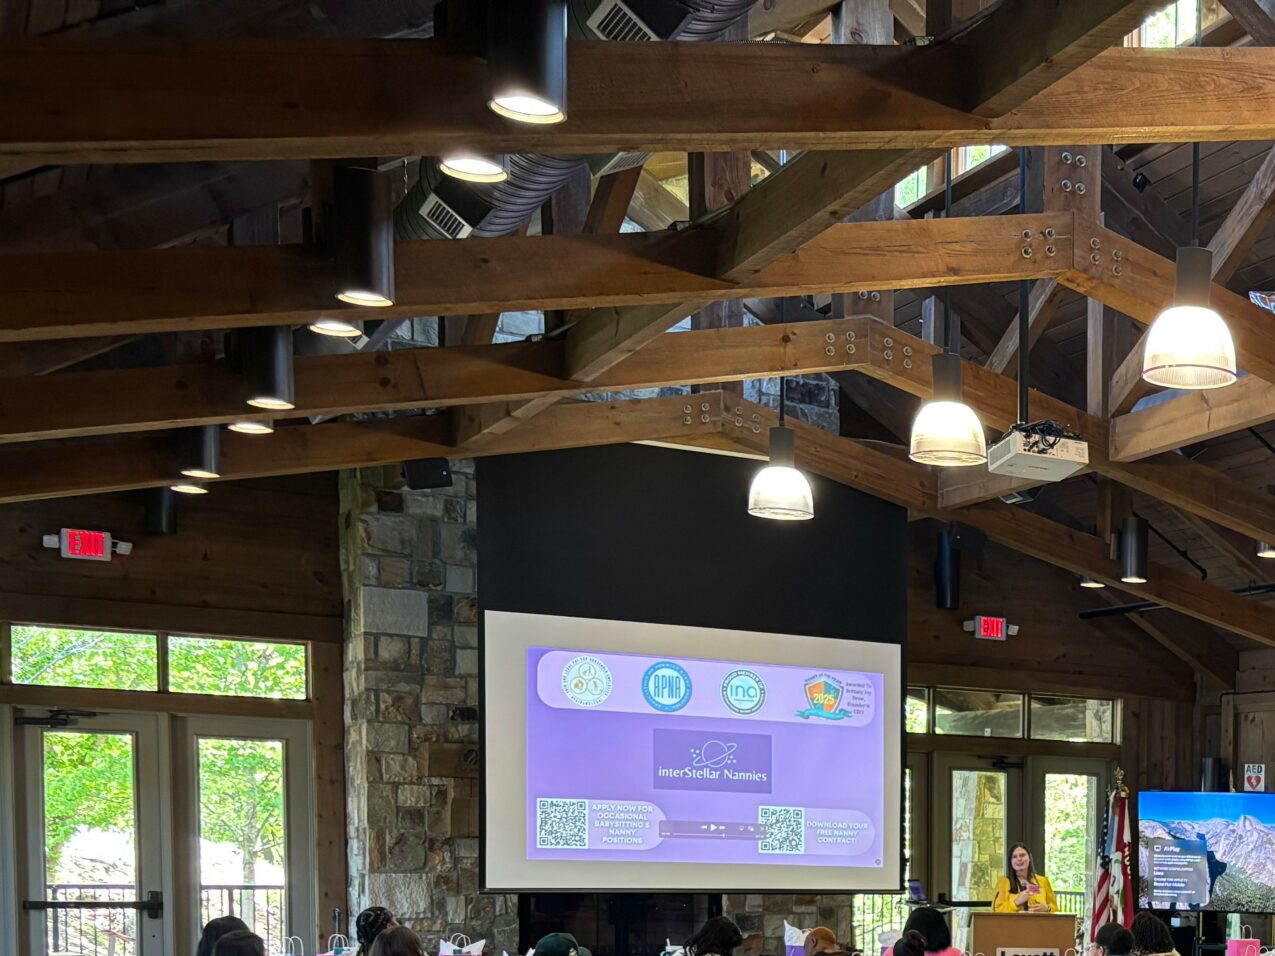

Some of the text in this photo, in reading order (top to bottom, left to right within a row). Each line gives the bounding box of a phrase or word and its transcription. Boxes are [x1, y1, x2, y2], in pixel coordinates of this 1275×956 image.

[68, 529, 105, 557] EXIT
[981, 616, 1003, 638] EXIT
[654, 673, 682, 700] APNA
[813, 693, 835, 705] 2025
[658, 766, 768, 782] interStellar Nannies
[1246, 764, 1263, 774] AED
[592, 804, 617, 812] APPLY
[618, 804, 637, 812] NOW
[597, 812, 649, 820] OCCASIONAL
[594, 820, 644, 828] BABYSITTING
[806, 820, 868, 830] DOWNLOAD YOUR
[608, 828, 637, 836] NANNY
[602, 836, 644, 844] POSITIONS
